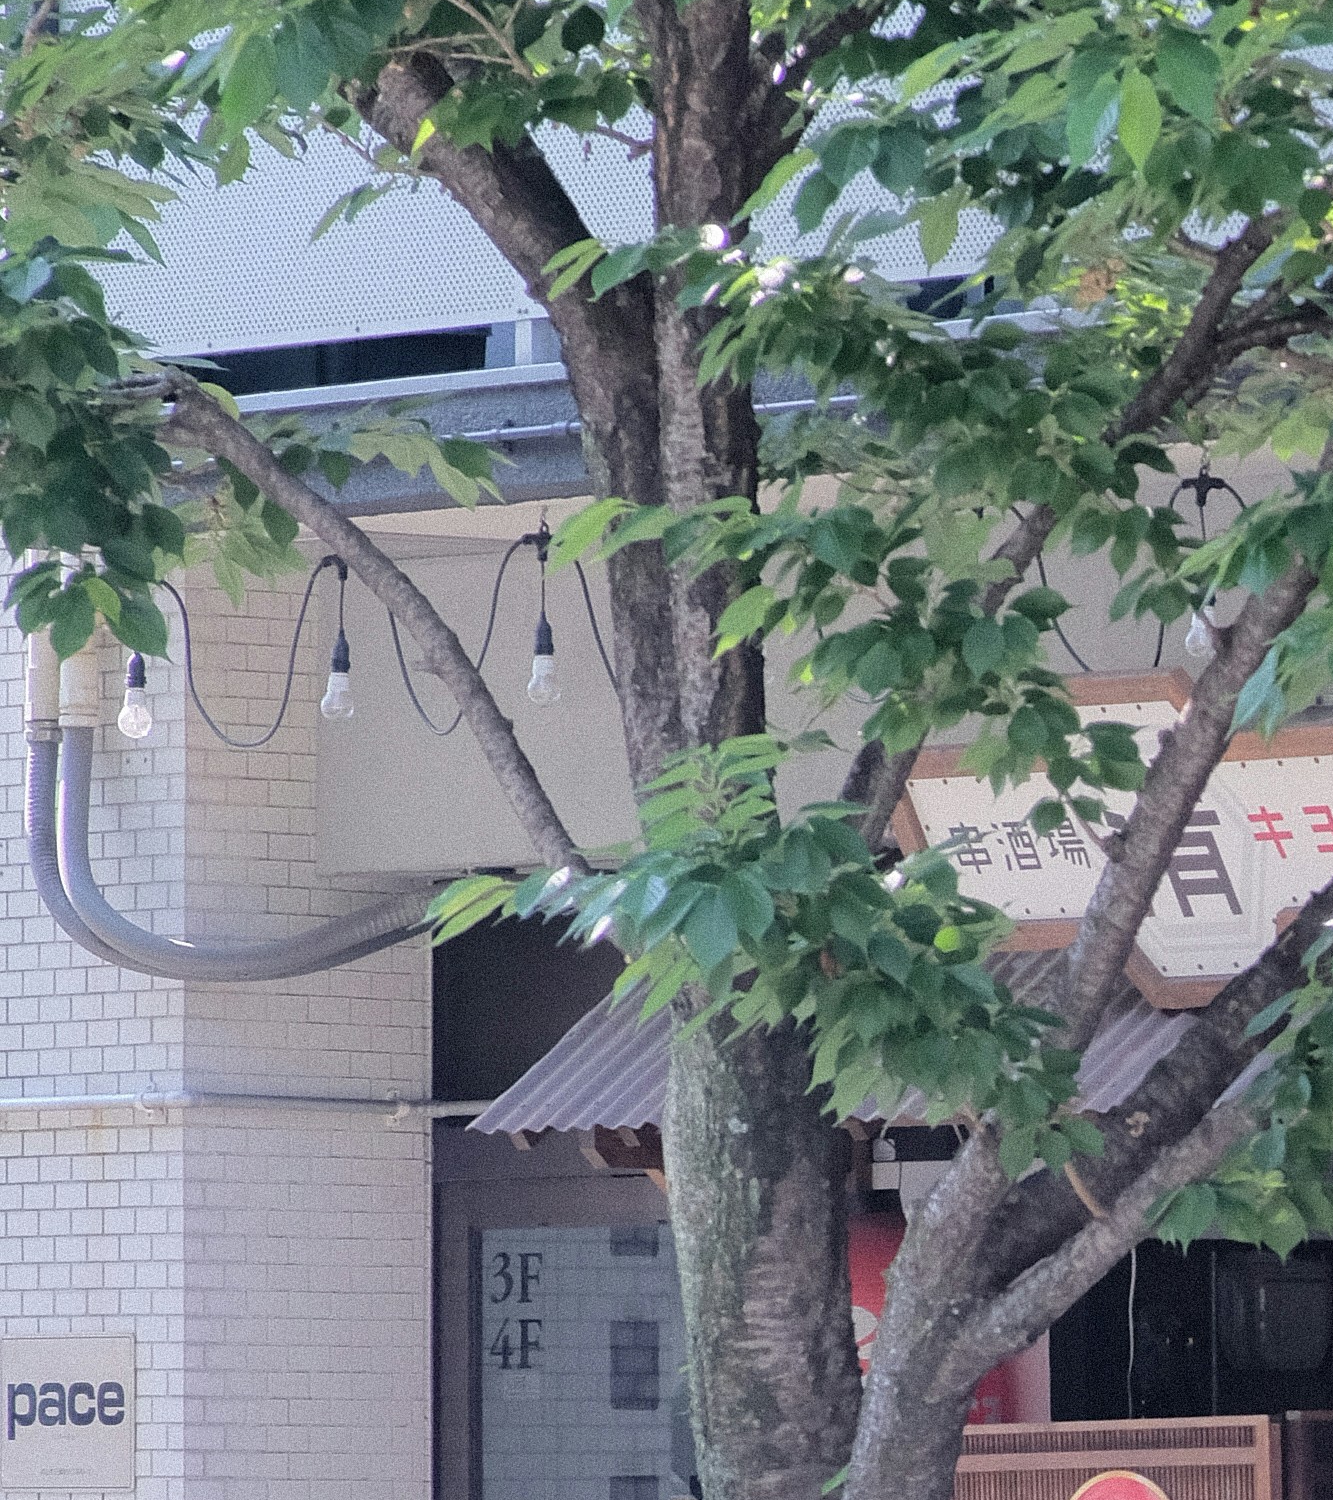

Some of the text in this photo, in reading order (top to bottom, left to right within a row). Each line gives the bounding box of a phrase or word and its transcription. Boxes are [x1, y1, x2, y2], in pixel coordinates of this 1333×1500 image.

[490, 1252, 544, 1304] 3F
[490, 1316, 544, 1370] 4F
[7, 1380, 126, 1441] pace
